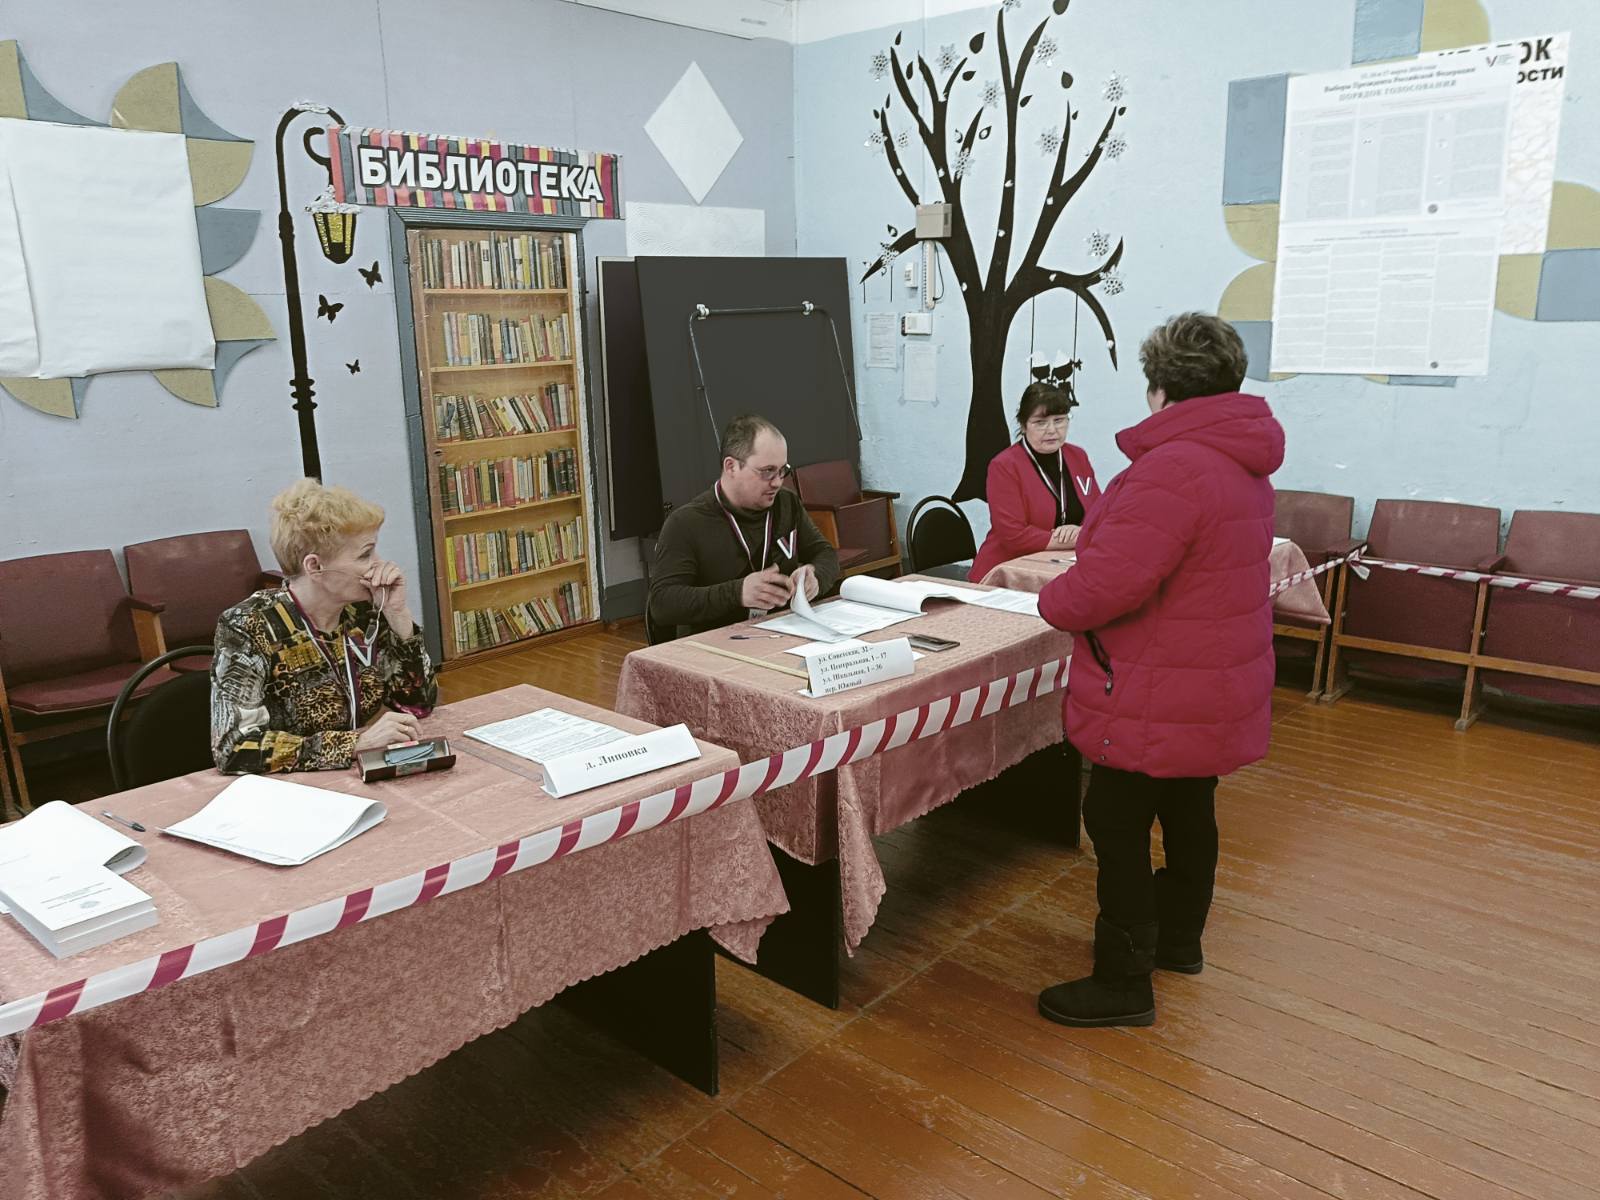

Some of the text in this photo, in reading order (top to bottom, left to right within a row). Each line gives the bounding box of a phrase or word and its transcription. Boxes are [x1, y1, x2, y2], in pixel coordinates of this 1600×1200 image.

[357, 145, 604, 202] БИБЛИОТЕКА
[585, 746, 648, 771] д. Липовка
